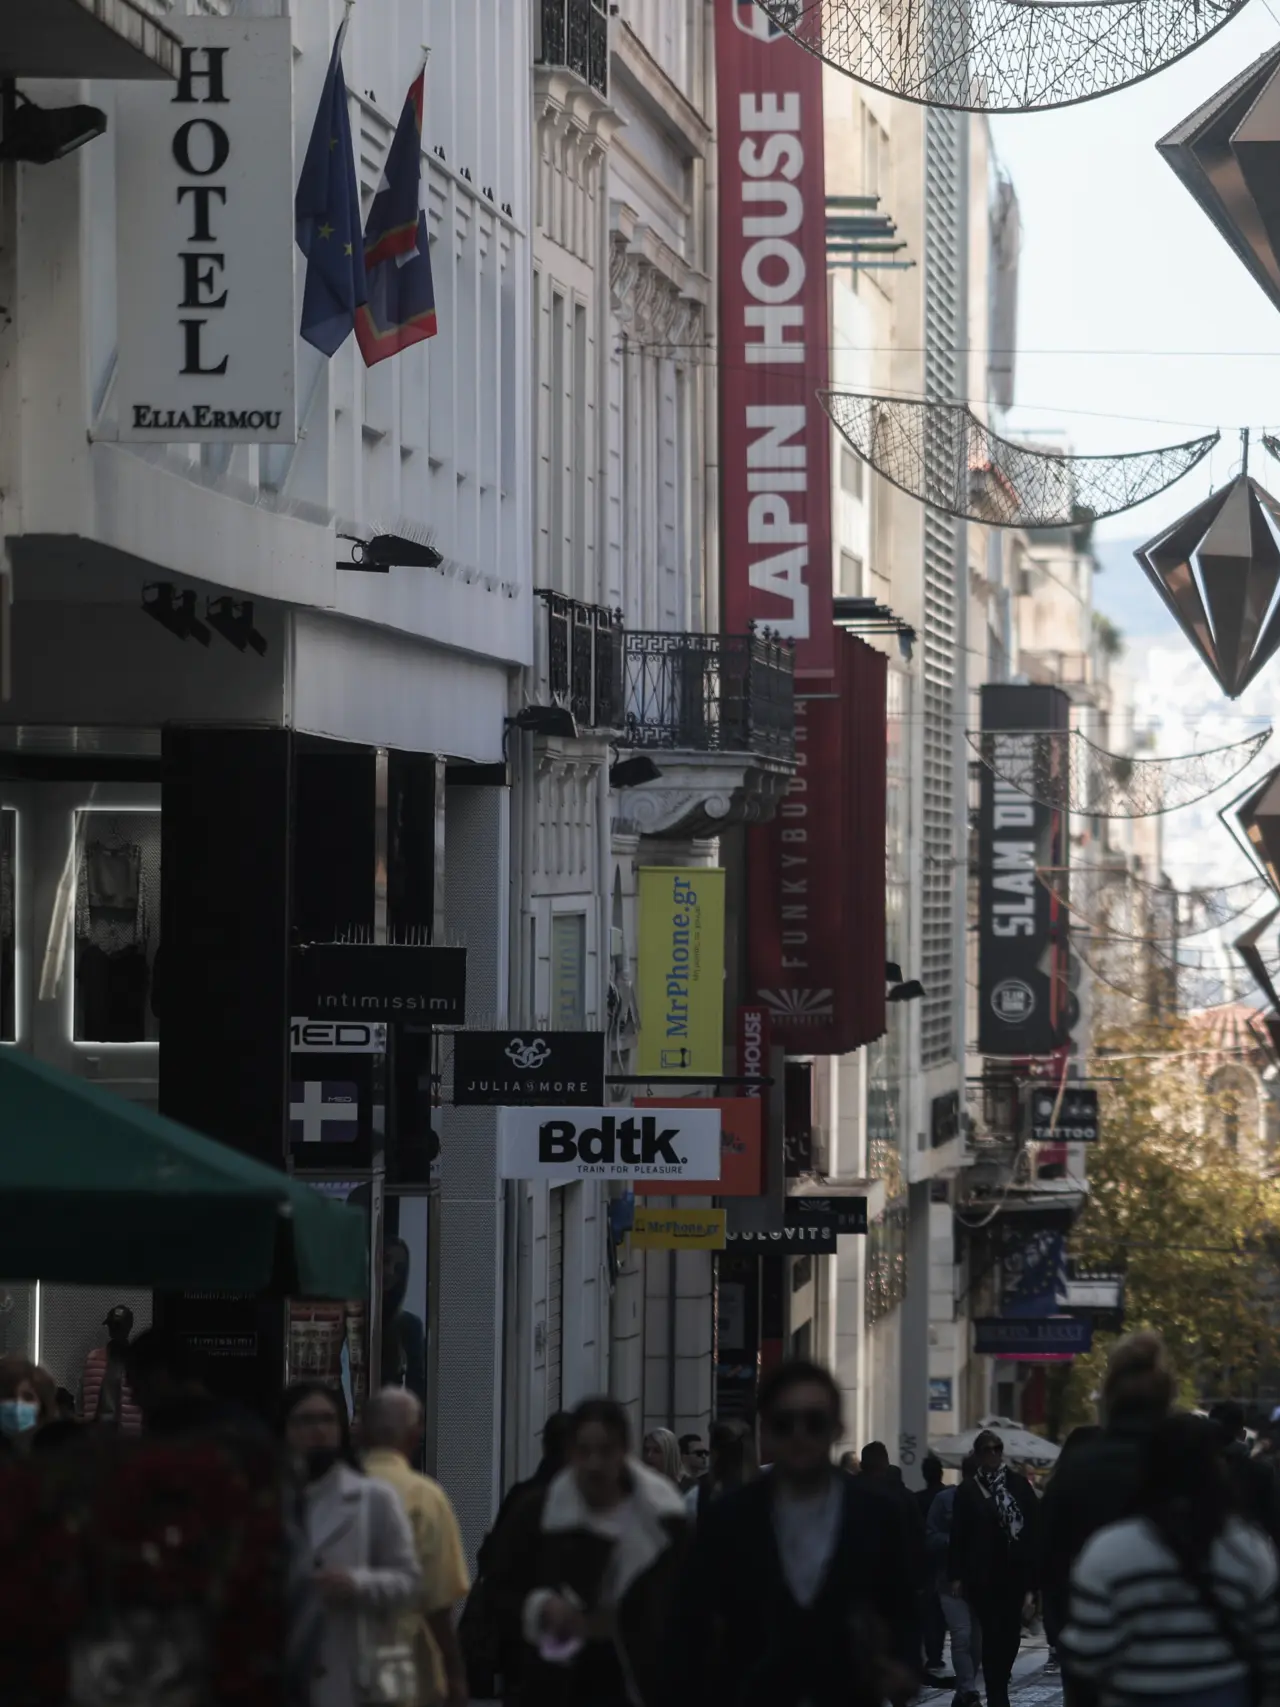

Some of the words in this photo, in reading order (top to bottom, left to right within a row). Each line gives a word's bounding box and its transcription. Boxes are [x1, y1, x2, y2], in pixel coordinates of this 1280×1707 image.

[171, 47, 230, 375] HOTEL
[739, 92, 807, 364] HOUSE
[745, 405, 810, 640] LAPIN
[991, 840, 1037, 938] SLAM
[664, 875, 698, 1039] MrPhone.gr
[317, 993, 458, 1011] intimissimi
[743, 1011, 762, 1077] HOUSE
[467, 1080, 522, 1092] JULIA
[539, 1081, 589, 1093] MORE
[577, 1166, 607, 1174] TRAIN
[611, 1166, 629, 1174] FOR
[634, 1166, 683, 1174] PLEASURE
[1033, 1129, 1096, 1139] TATTOO
